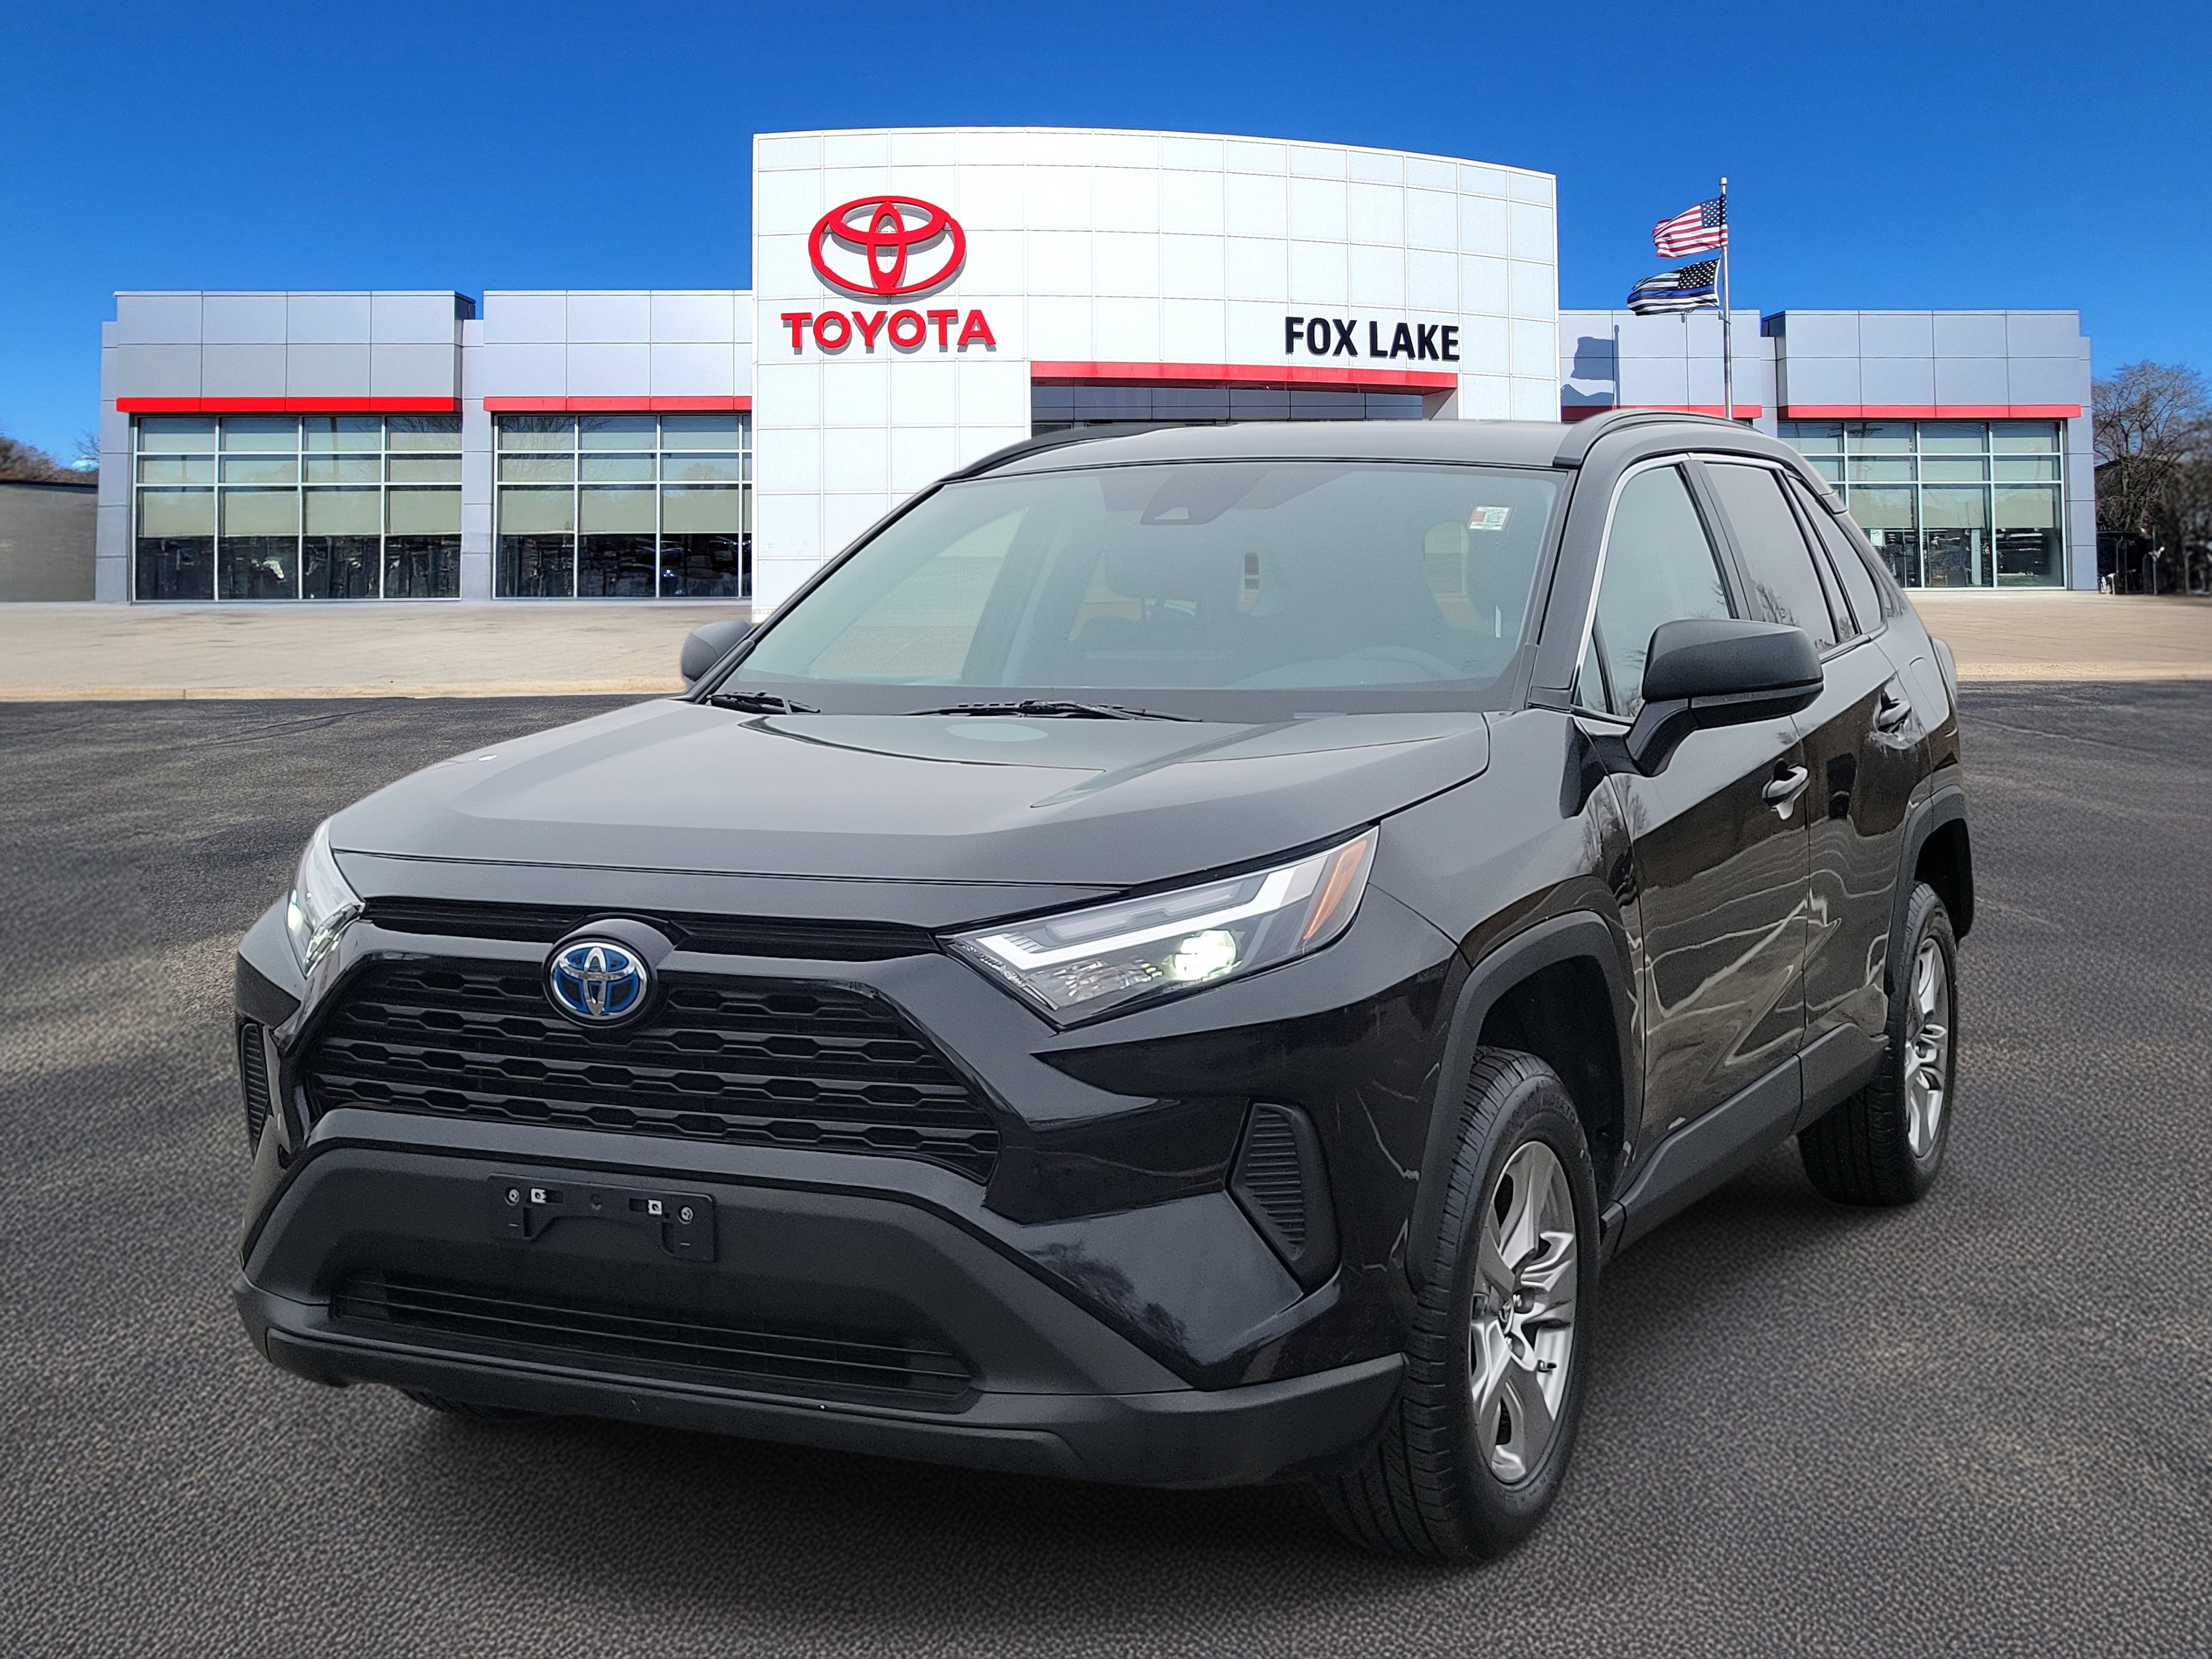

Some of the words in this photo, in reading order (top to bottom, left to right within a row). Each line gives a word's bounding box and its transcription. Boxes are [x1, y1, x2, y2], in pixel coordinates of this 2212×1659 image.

[781, 309, 996, 349] TOYOTA
[1285, 316, 1358, 356] FOX
[1369, 320, 1460, 360] LAKE
